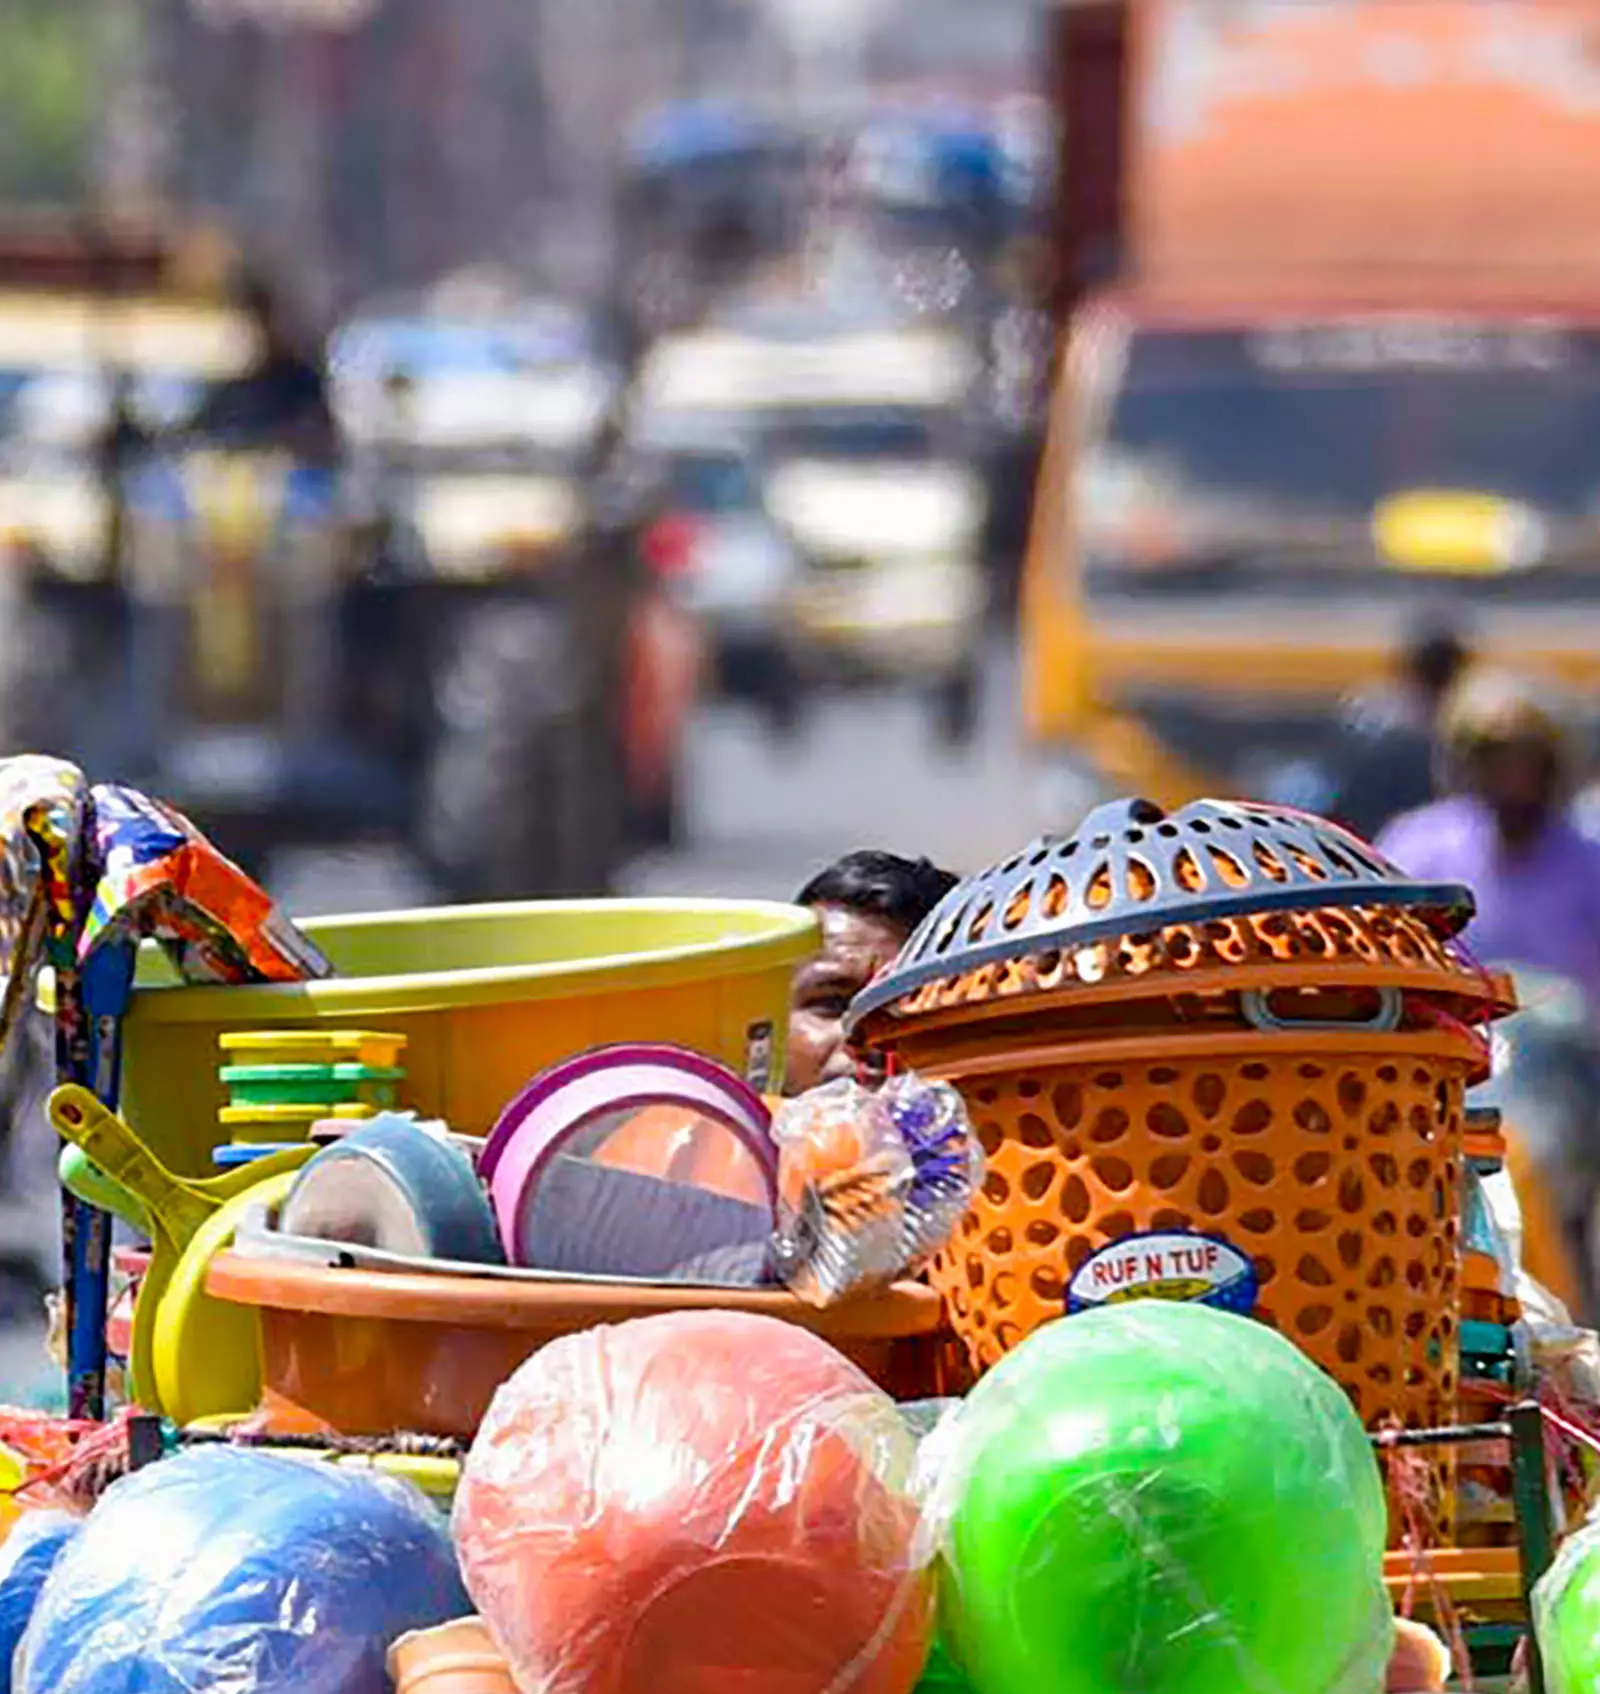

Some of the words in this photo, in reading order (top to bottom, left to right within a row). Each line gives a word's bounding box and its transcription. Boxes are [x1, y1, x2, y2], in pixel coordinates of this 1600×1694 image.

[1091, 1256, 1138, 1286] RUF
[1145, 1252, 1162, 1279] N
[1169, 1245, 1218, 1275] TUF
